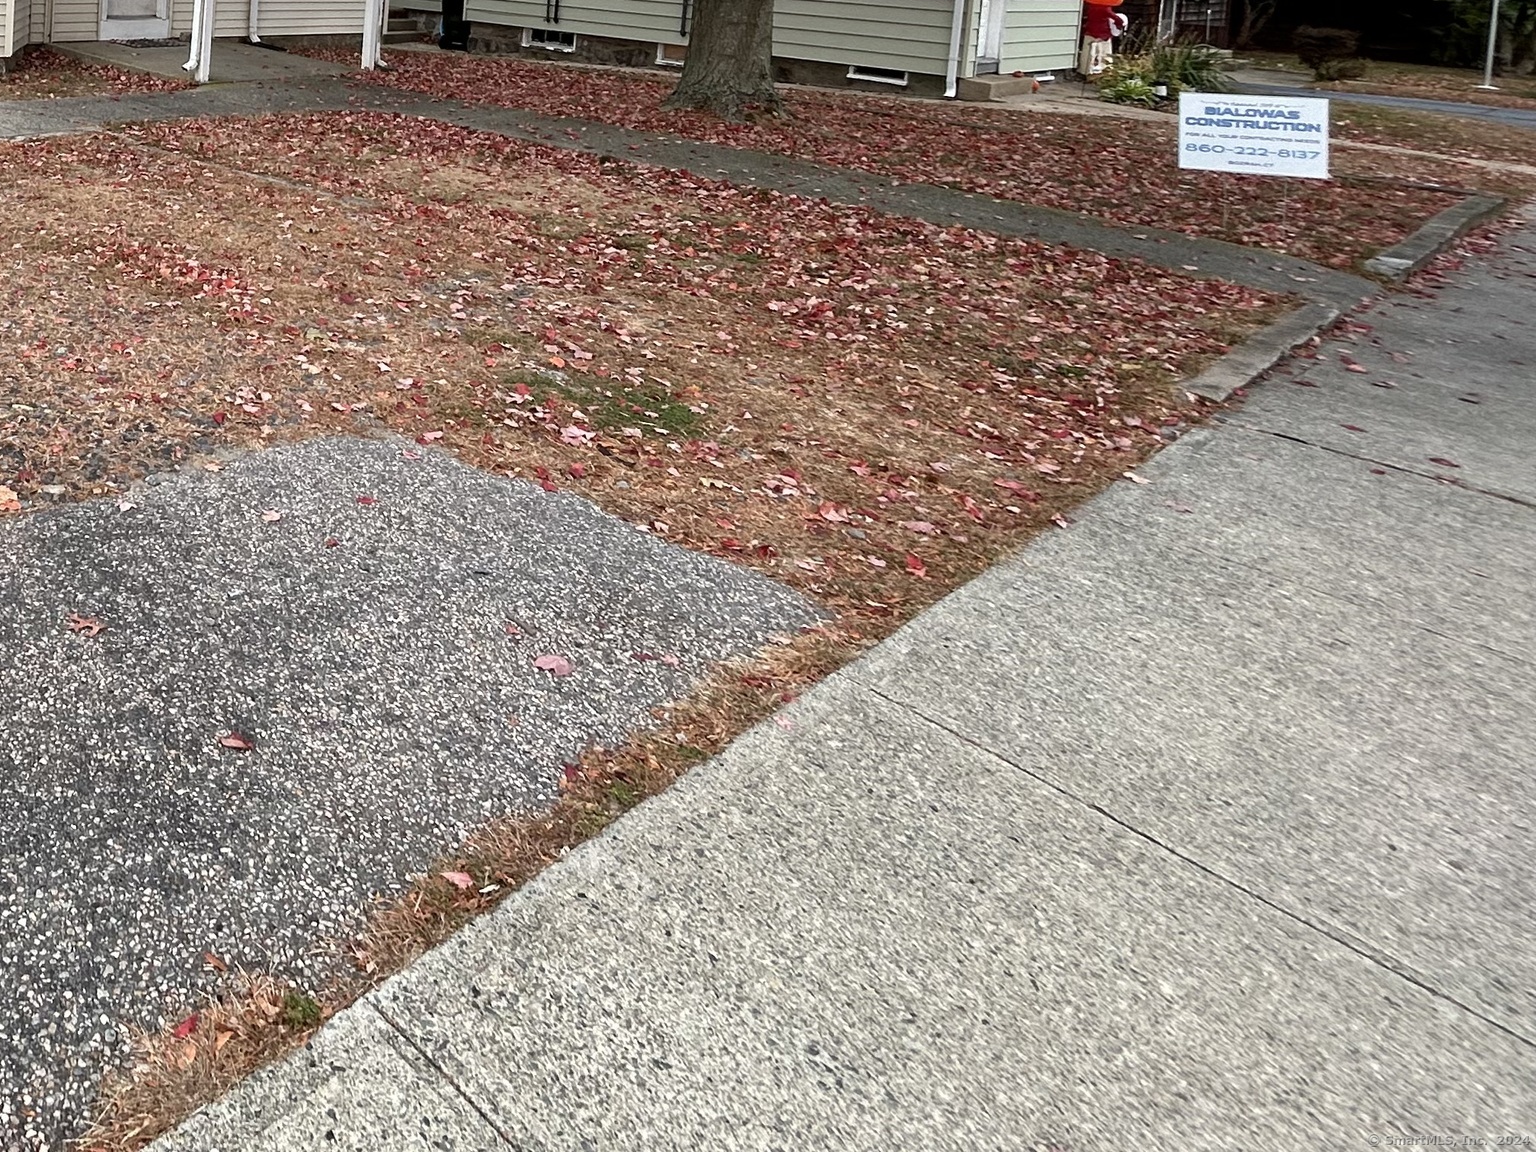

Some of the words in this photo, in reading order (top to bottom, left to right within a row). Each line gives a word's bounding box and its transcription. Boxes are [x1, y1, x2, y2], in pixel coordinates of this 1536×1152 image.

[1204, 106, 1301, 119] BIALOWAS
[1185, 117, 1322, 133] CONSTRUCTION
[1185, 143, 1321, 159] 860-222-8137
